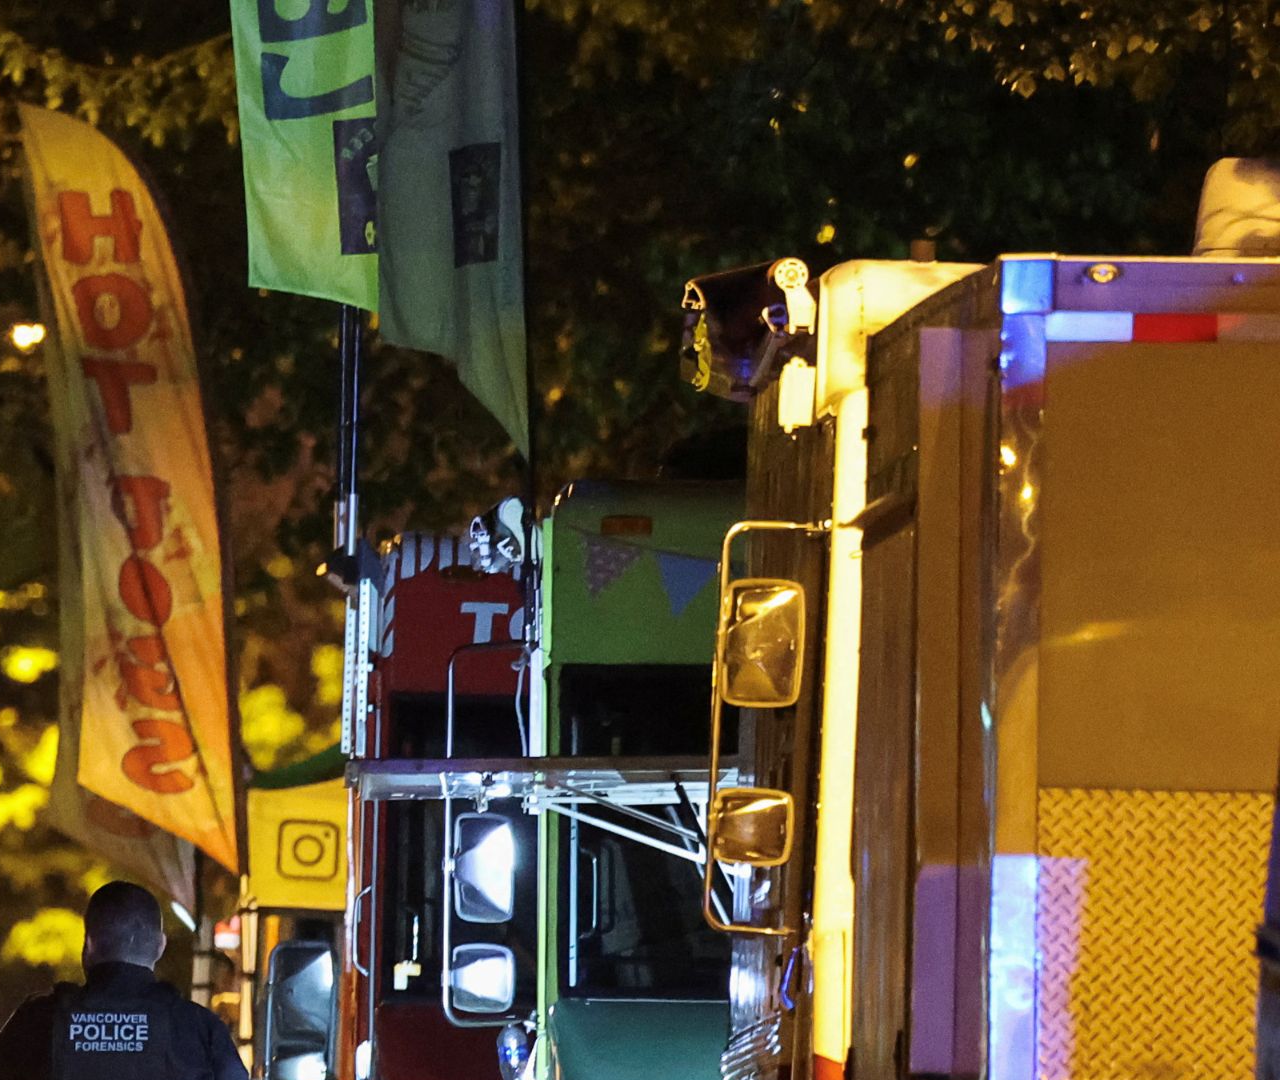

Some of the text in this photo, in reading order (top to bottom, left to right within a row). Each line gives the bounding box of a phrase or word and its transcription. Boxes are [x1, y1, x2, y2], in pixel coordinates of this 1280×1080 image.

[71, 1013, 148, 1024] VANCOUVER
[69, 1024, 149, 1040] POLICE
[74, 1041, 144, 1052] FORENSICS
